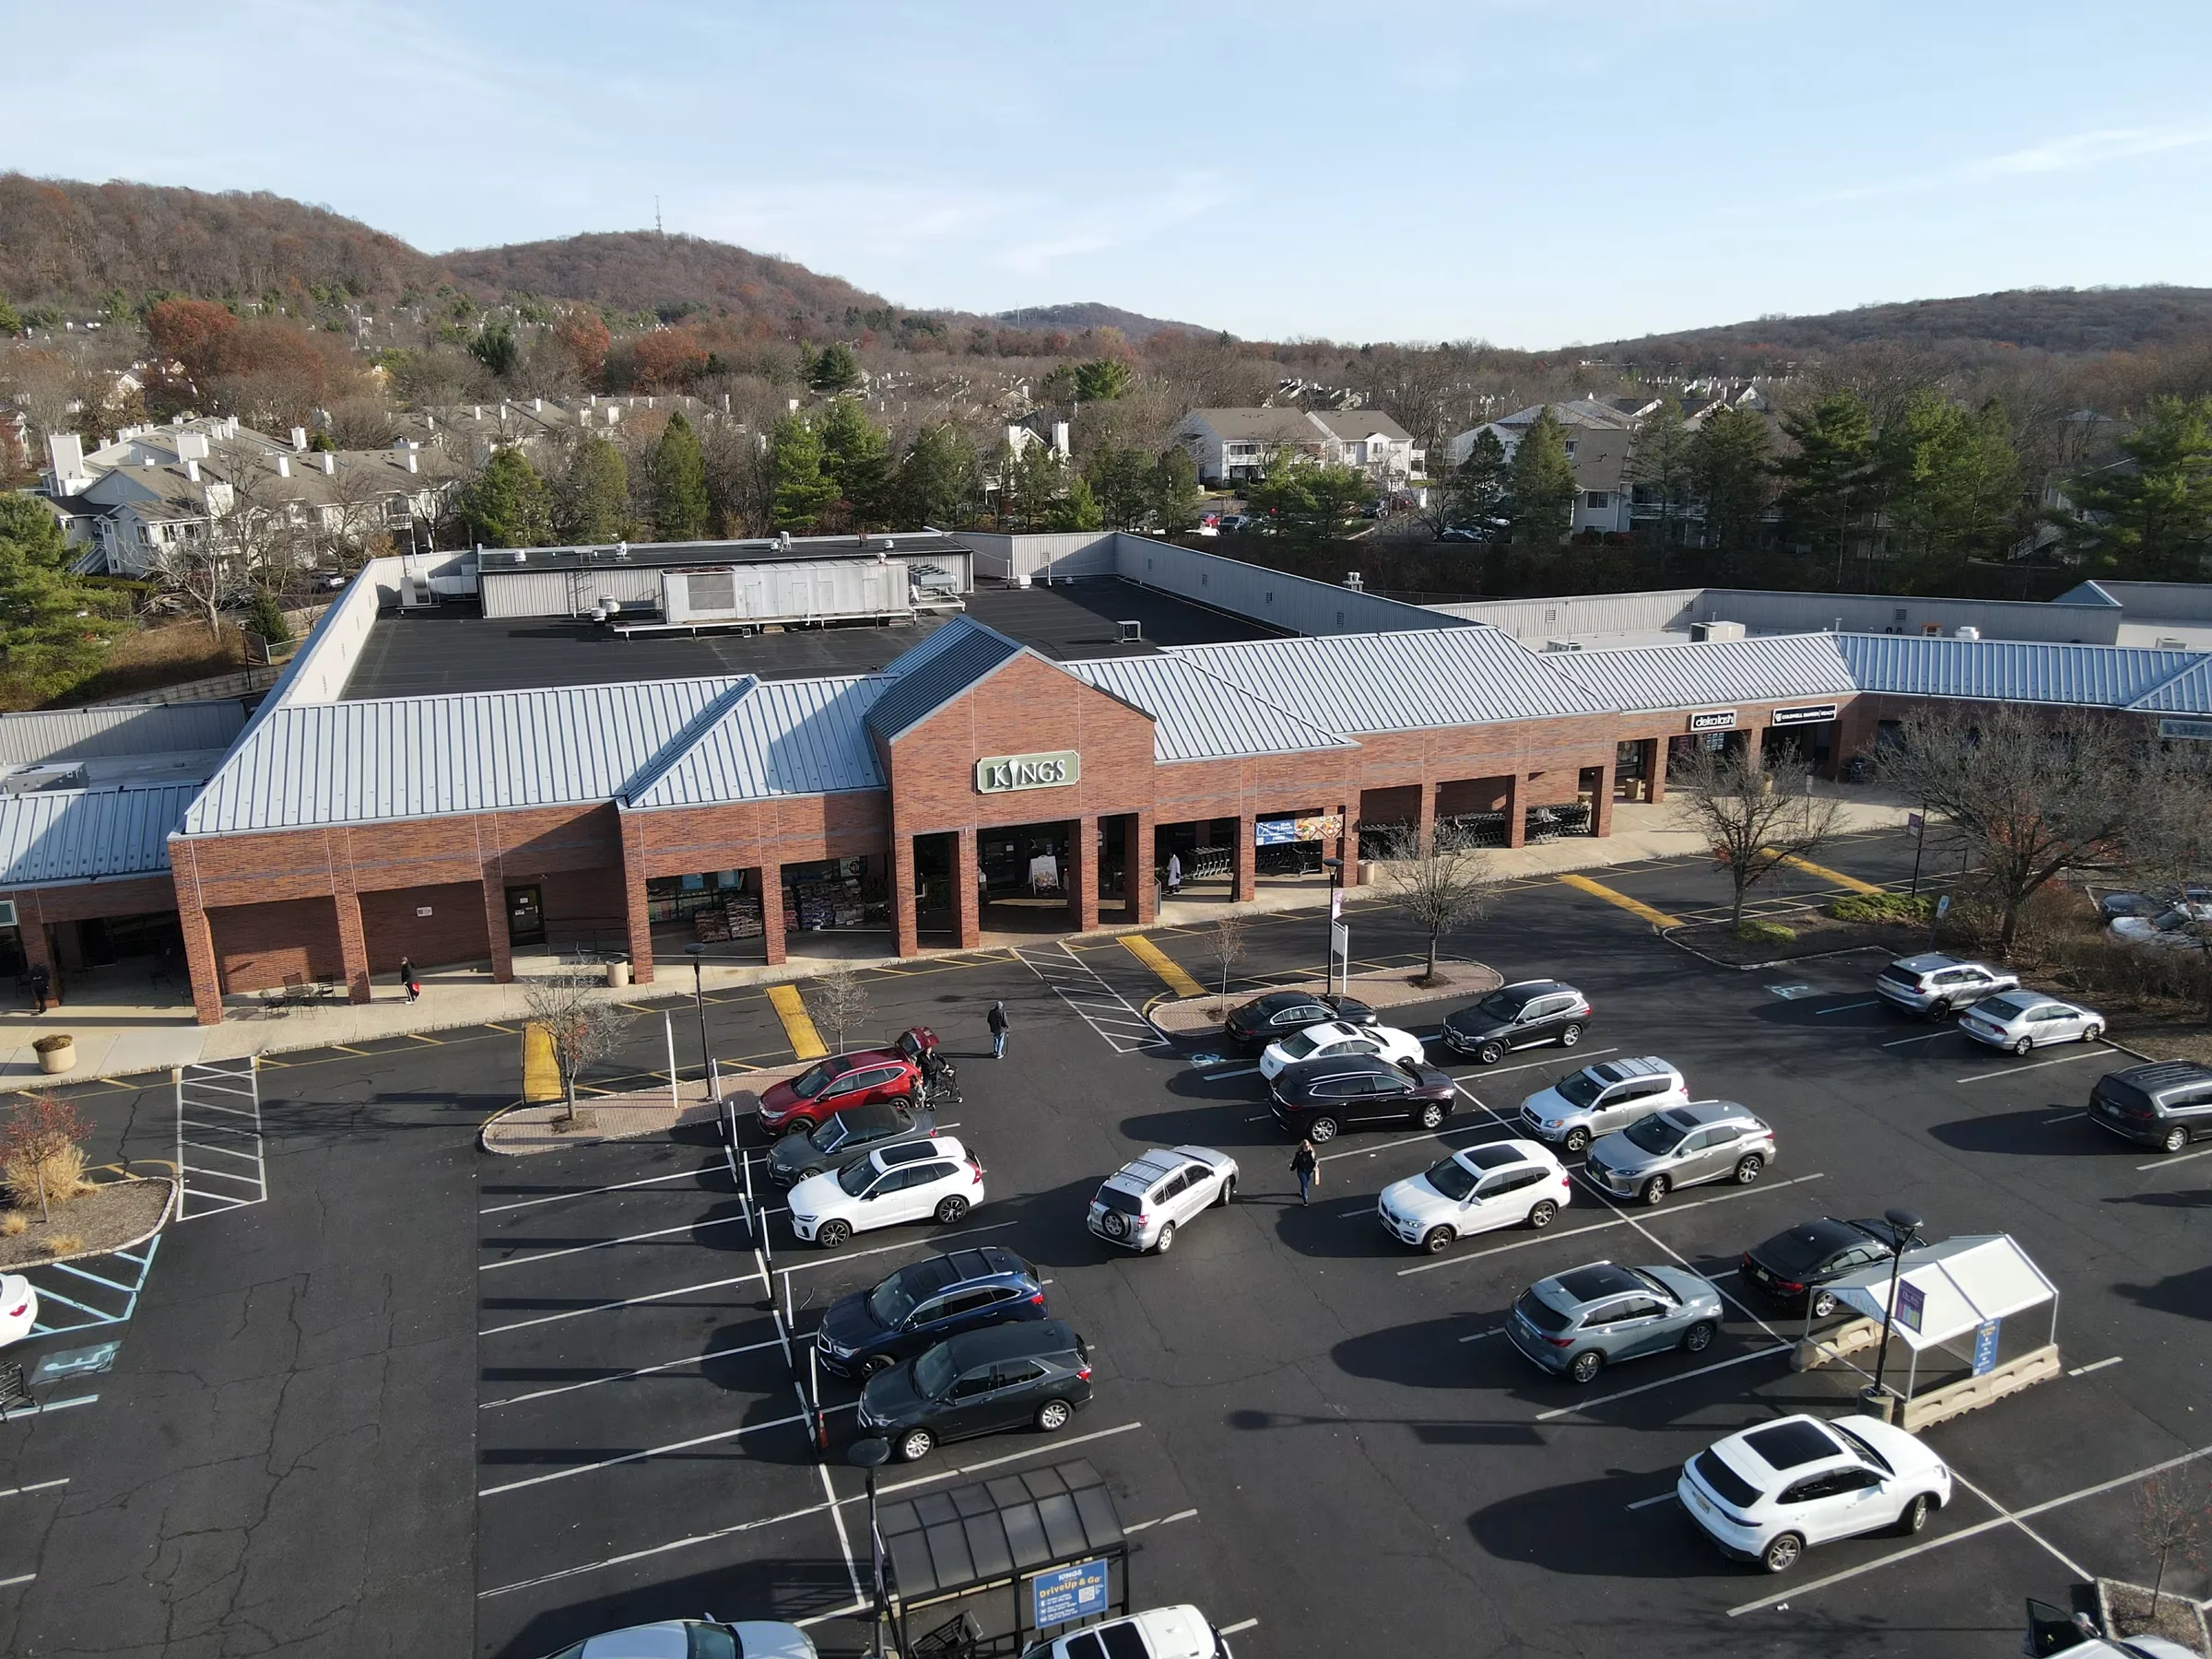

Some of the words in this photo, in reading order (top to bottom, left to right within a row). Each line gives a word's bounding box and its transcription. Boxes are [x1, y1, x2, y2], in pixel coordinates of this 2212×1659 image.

[993, 759, 1066, 789] KINGS
[1059, 1570, 1083, 1581] KINGS
[1040, 1582, 1077, 1598] DriveUp
